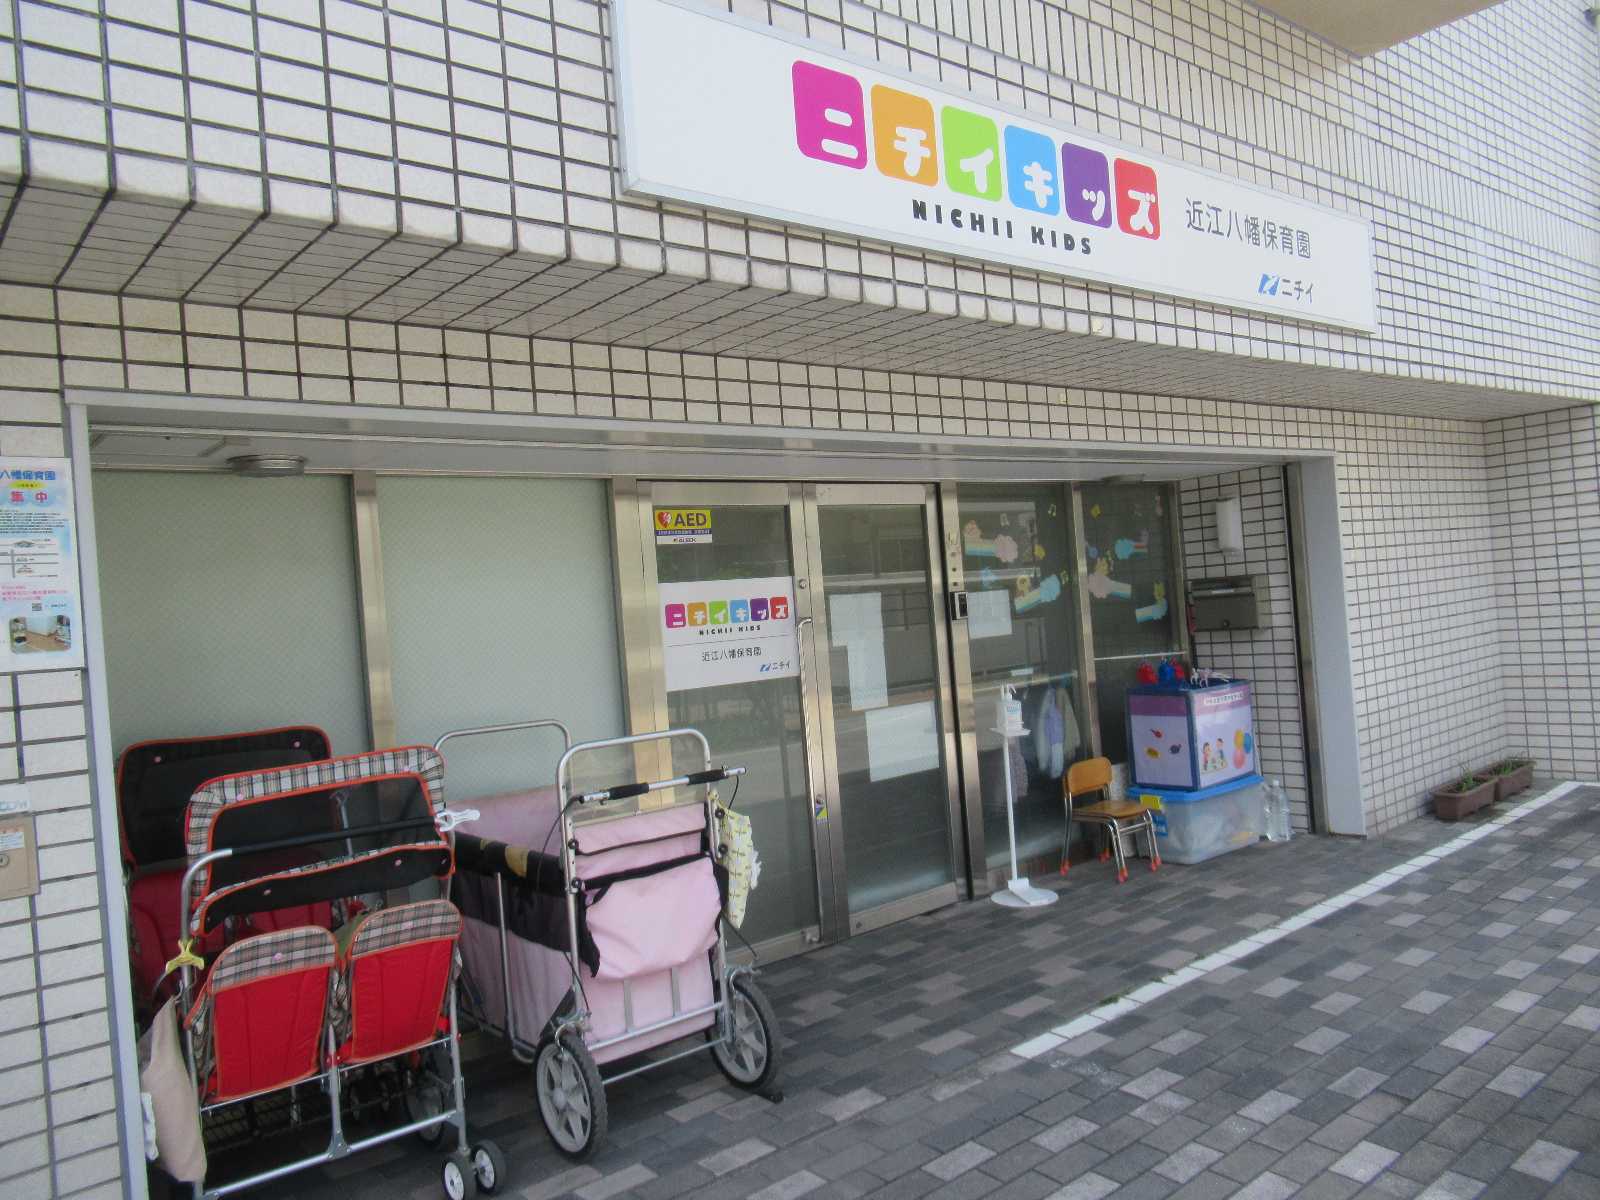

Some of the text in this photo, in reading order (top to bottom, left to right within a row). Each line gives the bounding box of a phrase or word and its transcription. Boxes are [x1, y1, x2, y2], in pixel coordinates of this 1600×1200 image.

[821, 107, 1155, 236] ニチイキッズ
[911, 199, 1092, 255] NICHII KIDS
[1186, 197, 1311, 259] 近江八幡保育園
[1281, 278, 1314, 304] ニチイ
[674, 512, 707, 527] AED
[672, 604, 788, 626] ニチイキッズ
[699, 624, 761, 635] NICHII KIDS
[702, 646, 761, 661] 近江八幡保育園
[772, 660, 790, 671] ニチイ
